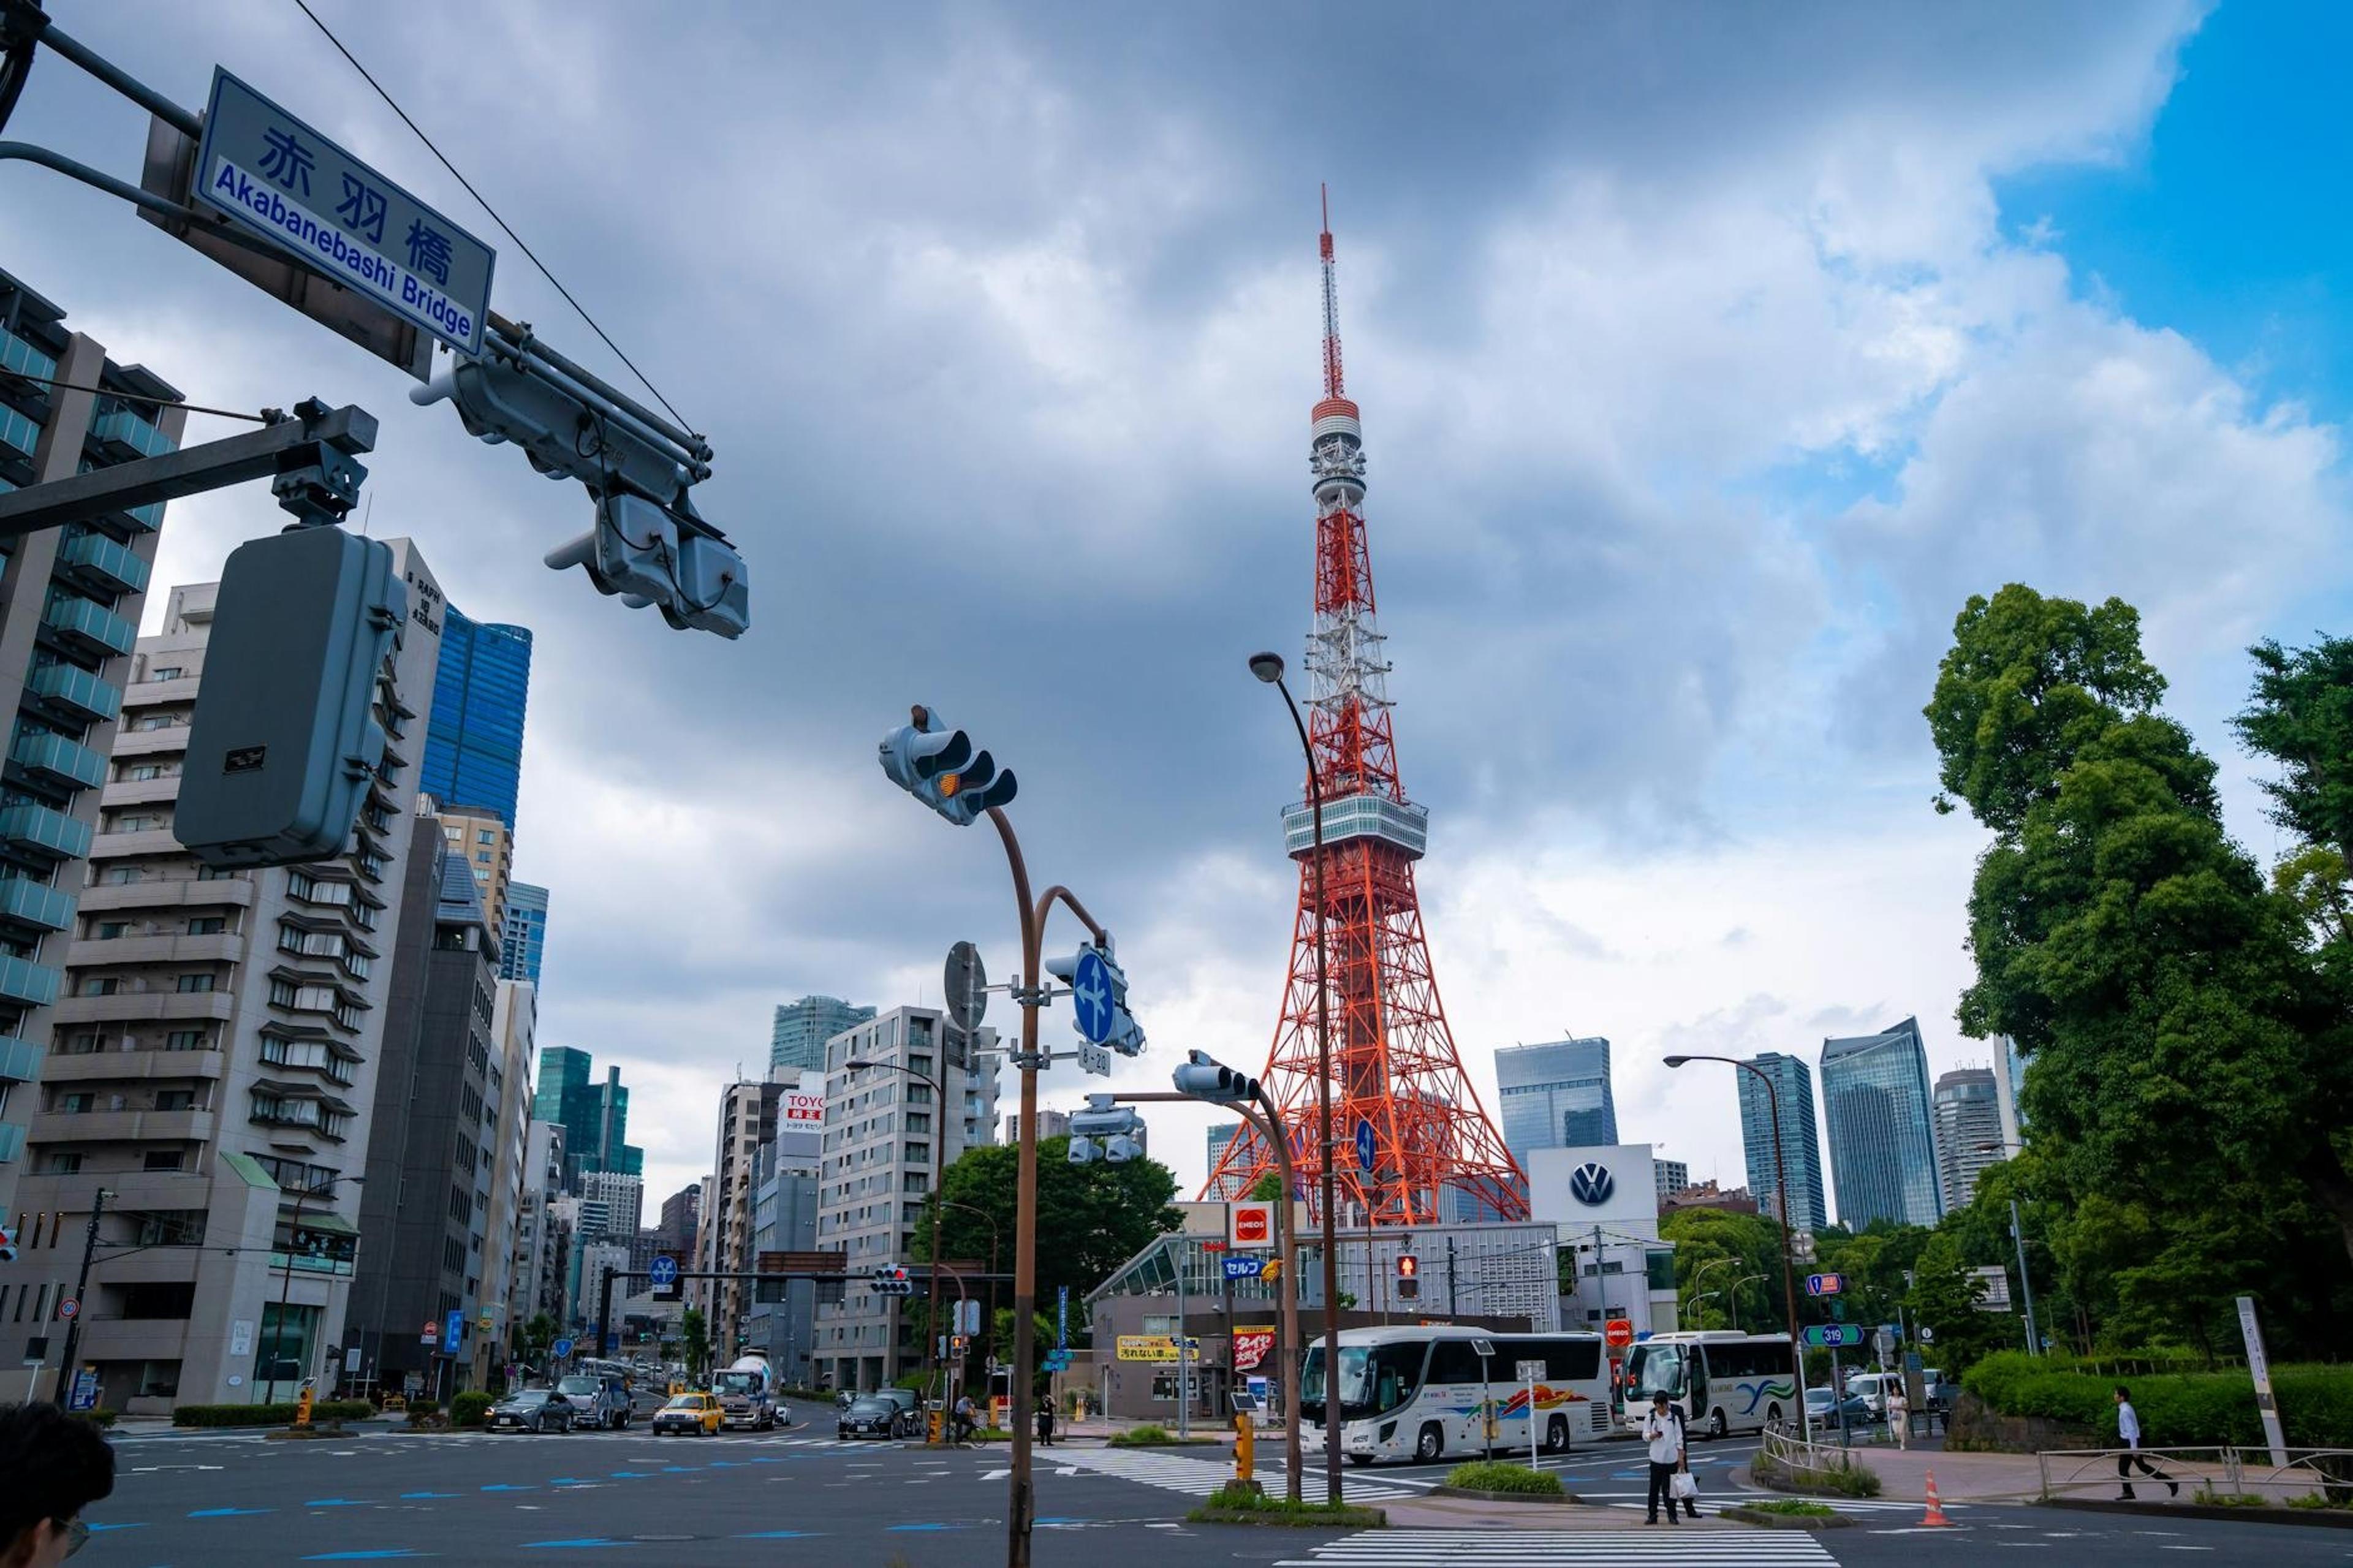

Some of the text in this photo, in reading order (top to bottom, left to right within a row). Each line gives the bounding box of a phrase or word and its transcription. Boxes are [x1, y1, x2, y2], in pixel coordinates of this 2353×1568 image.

[259, 126, 453, 287] 赤羽橋
[216, 164, 471, 338] Akabanebashi Bridge
[1096, 1053, 1106, 1070] 20
[1238, 1221, 1265, 1229] ENEOS
[1226, 1262, 1259, 1275] セルフ
[1824, 1330, 1841, 1341] 319
